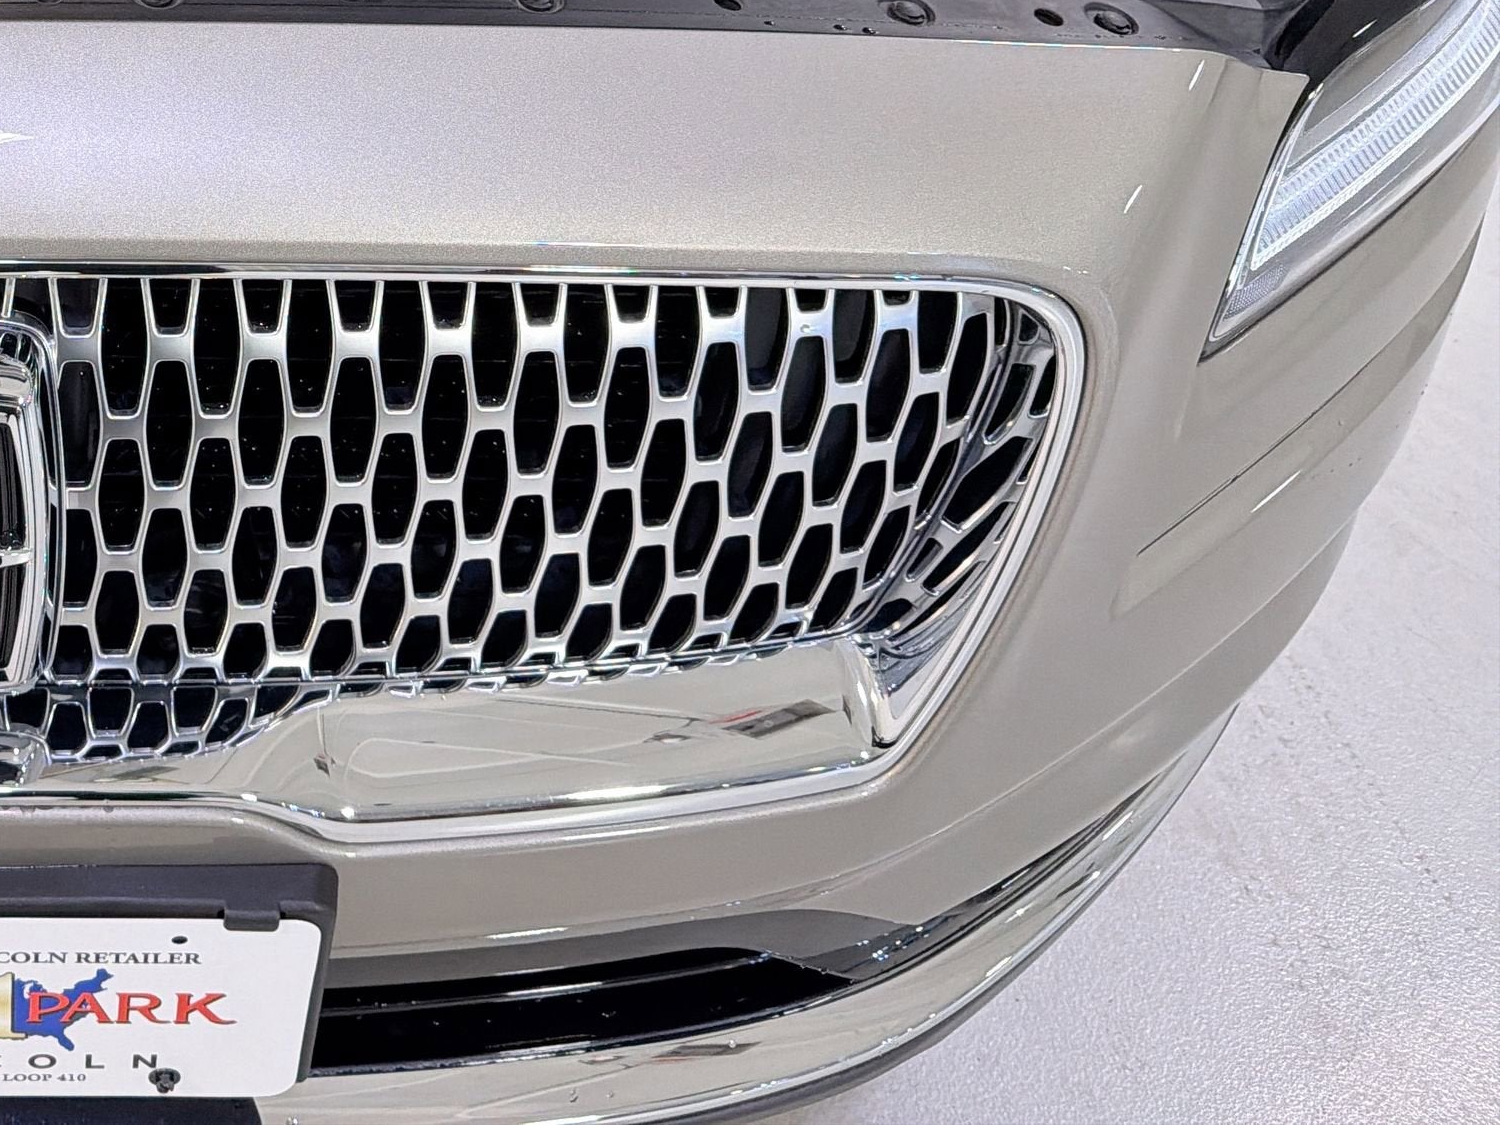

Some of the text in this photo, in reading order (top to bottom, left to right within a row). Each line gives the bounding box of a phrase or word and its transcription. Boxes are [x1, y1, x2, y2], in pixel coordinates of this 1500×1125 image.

[74, 951, 202, 965] RETAILER
[26, 991, 238, 1025] PARK
[2, 1073, 52, 1082] LOOP
[57, 1073, 86, 1083] 410
